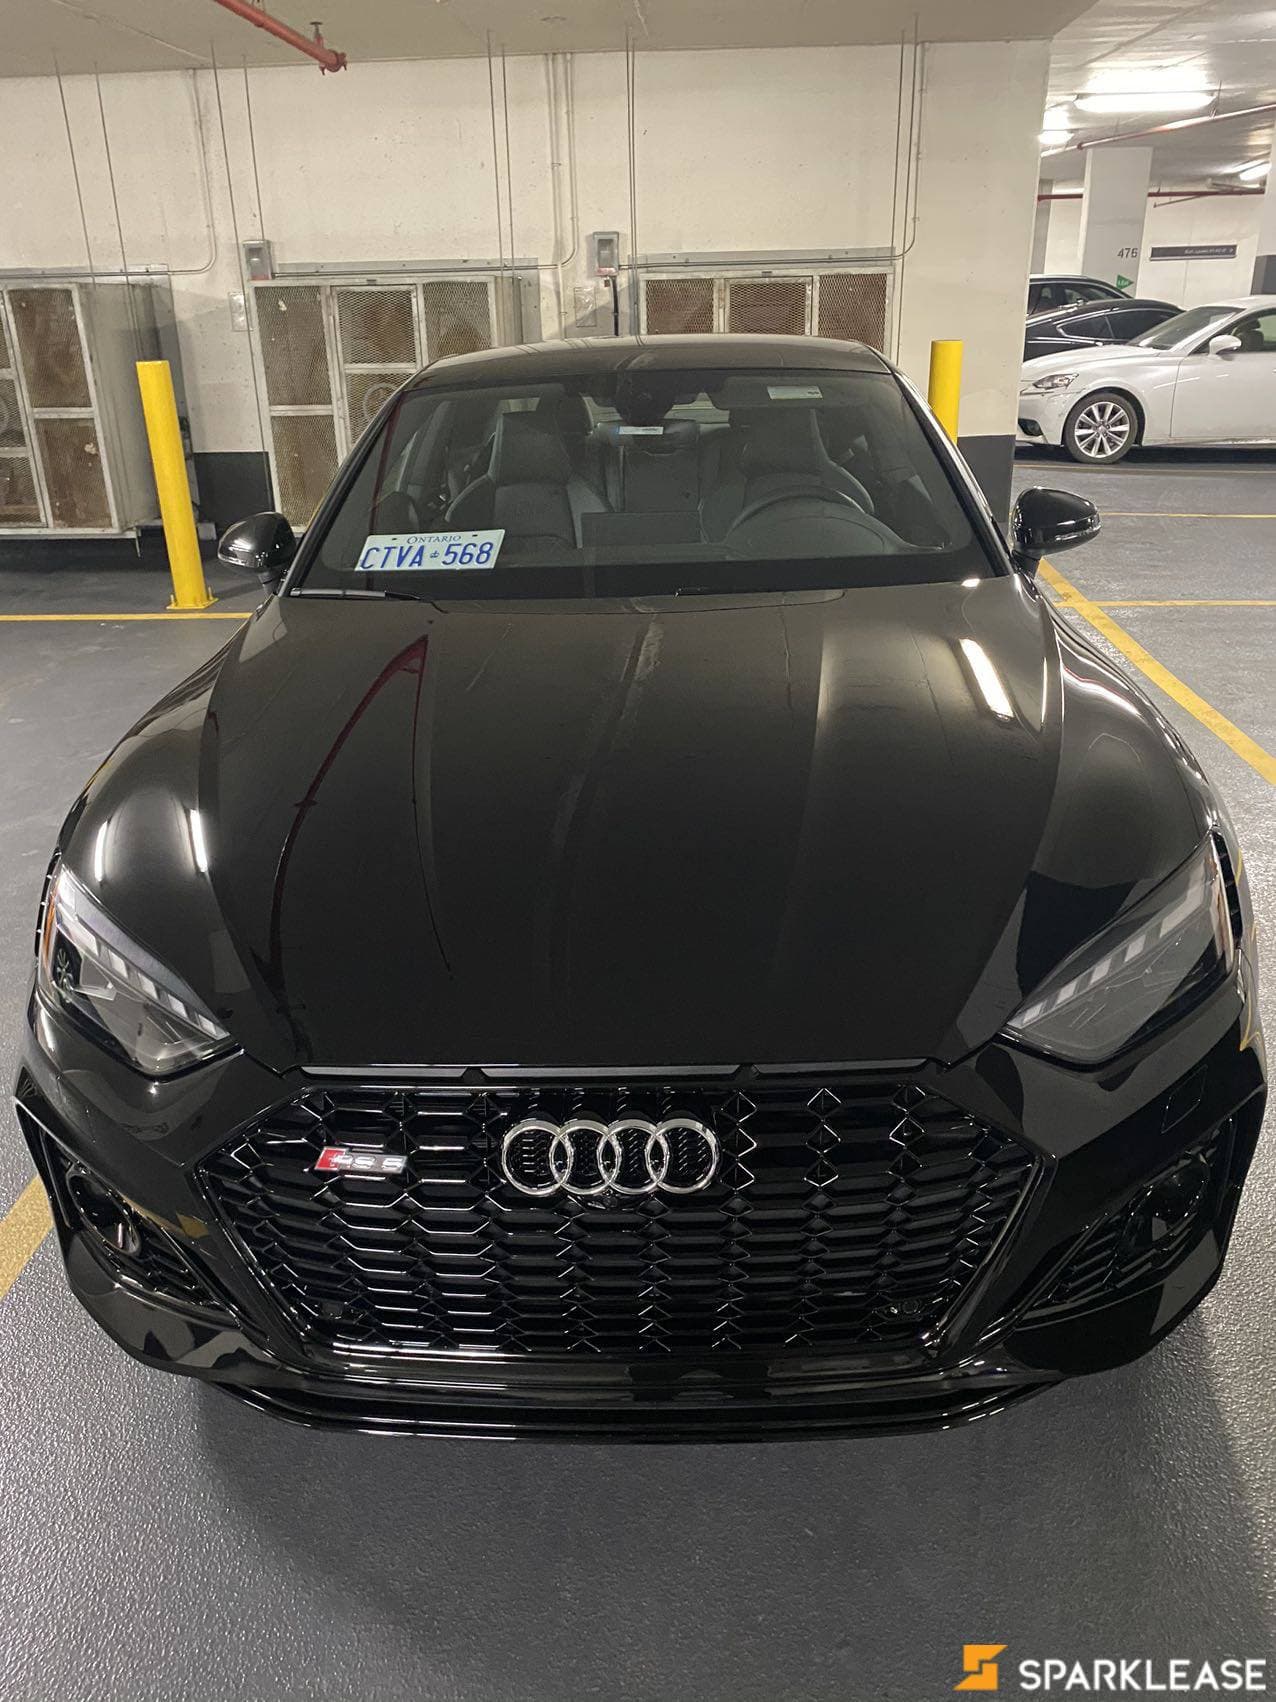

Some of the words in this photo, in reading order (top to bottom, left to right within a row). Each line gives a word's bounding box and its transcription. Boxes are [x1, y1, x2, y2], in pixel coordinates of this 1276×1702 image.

[1117, 247, 1138, 259] 476
[406, 535, 462, 545] ONTARIO
[360, 545, 425, 570] CTVA
[442, 541, 494, 566] 568
